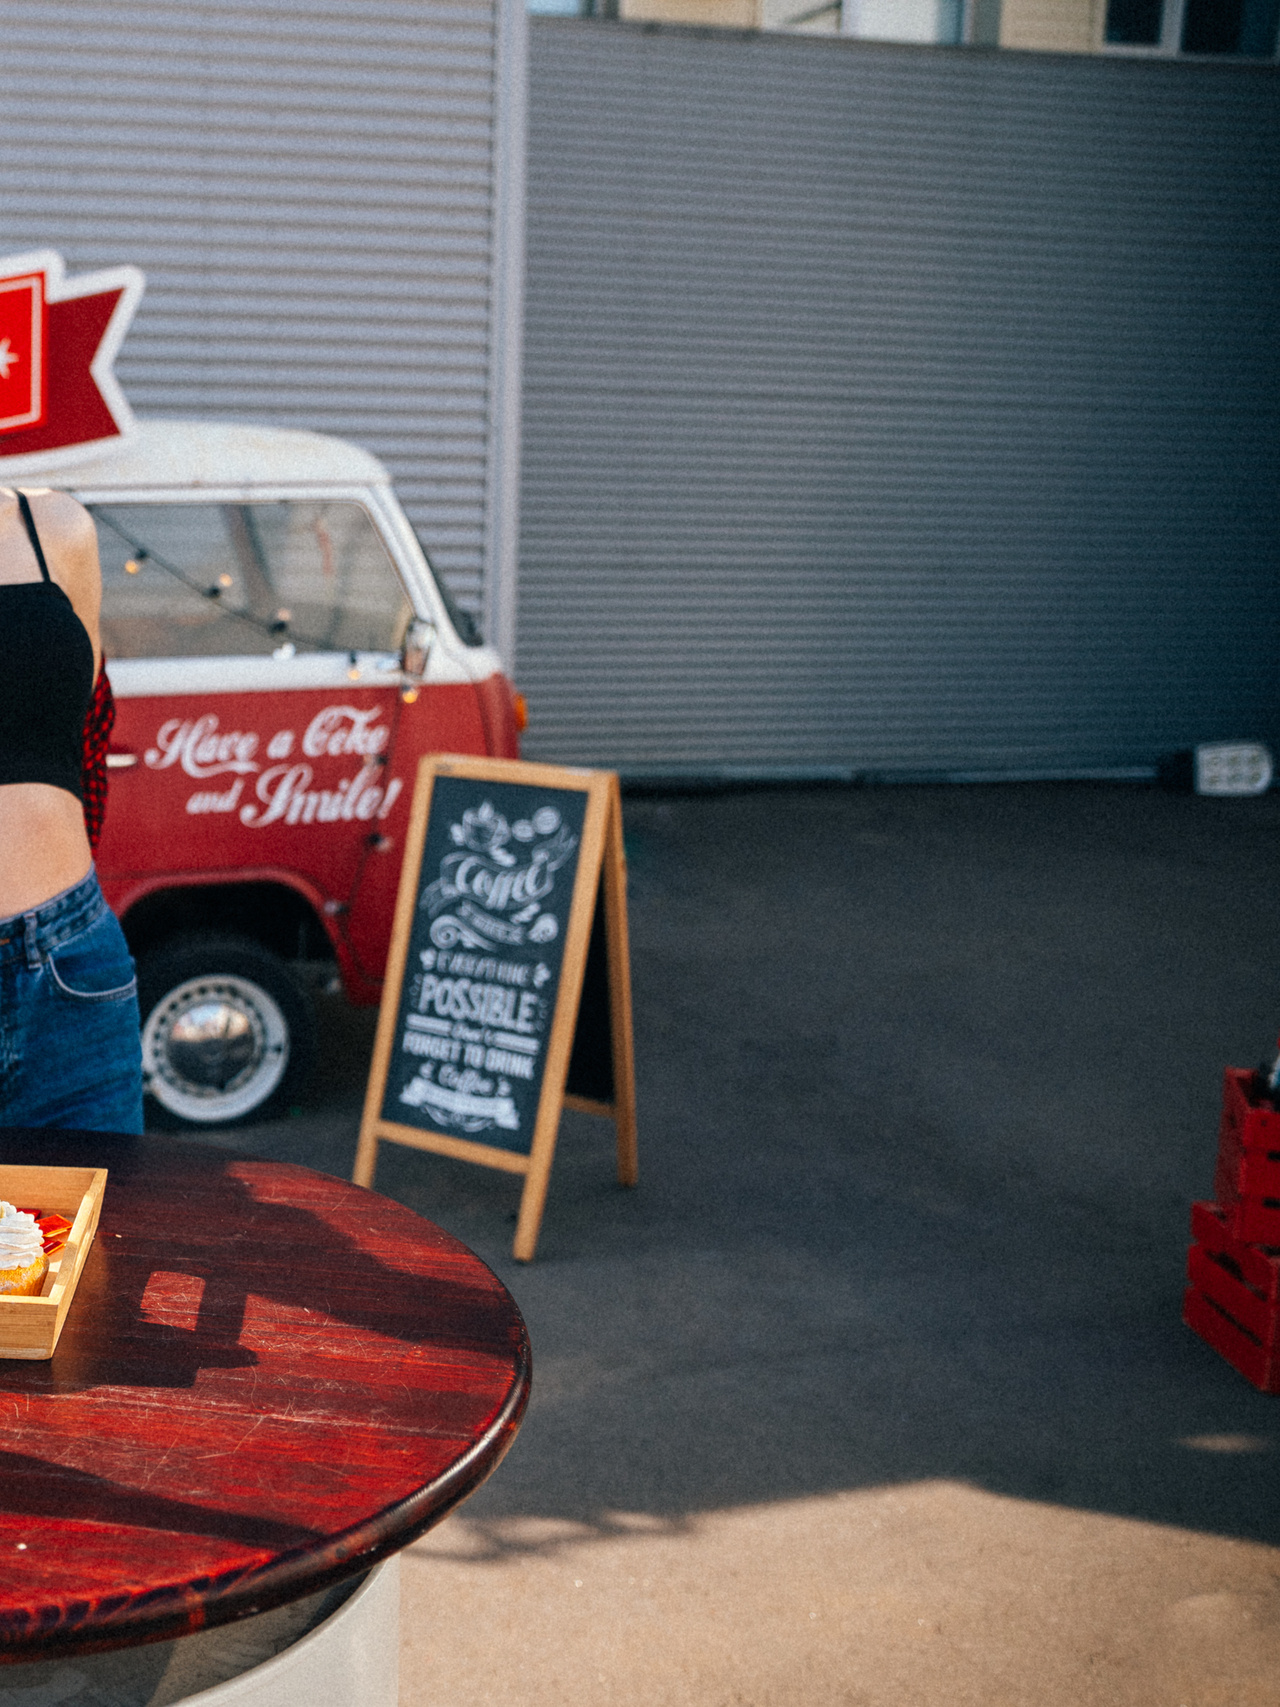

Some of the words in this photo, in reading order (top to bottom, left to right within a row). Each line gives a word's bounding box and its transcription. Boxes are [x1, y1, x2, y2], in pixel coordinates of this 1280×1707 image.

[144, 713, 260, 778] Have
[267, 730, 295, 759] a
[302, 704, 390, 757] Coke
[186, 778, 245, 814] and
[239, 762, 403, 828] Smile!
[419, 973, 539, 1034] POSSIBLE
